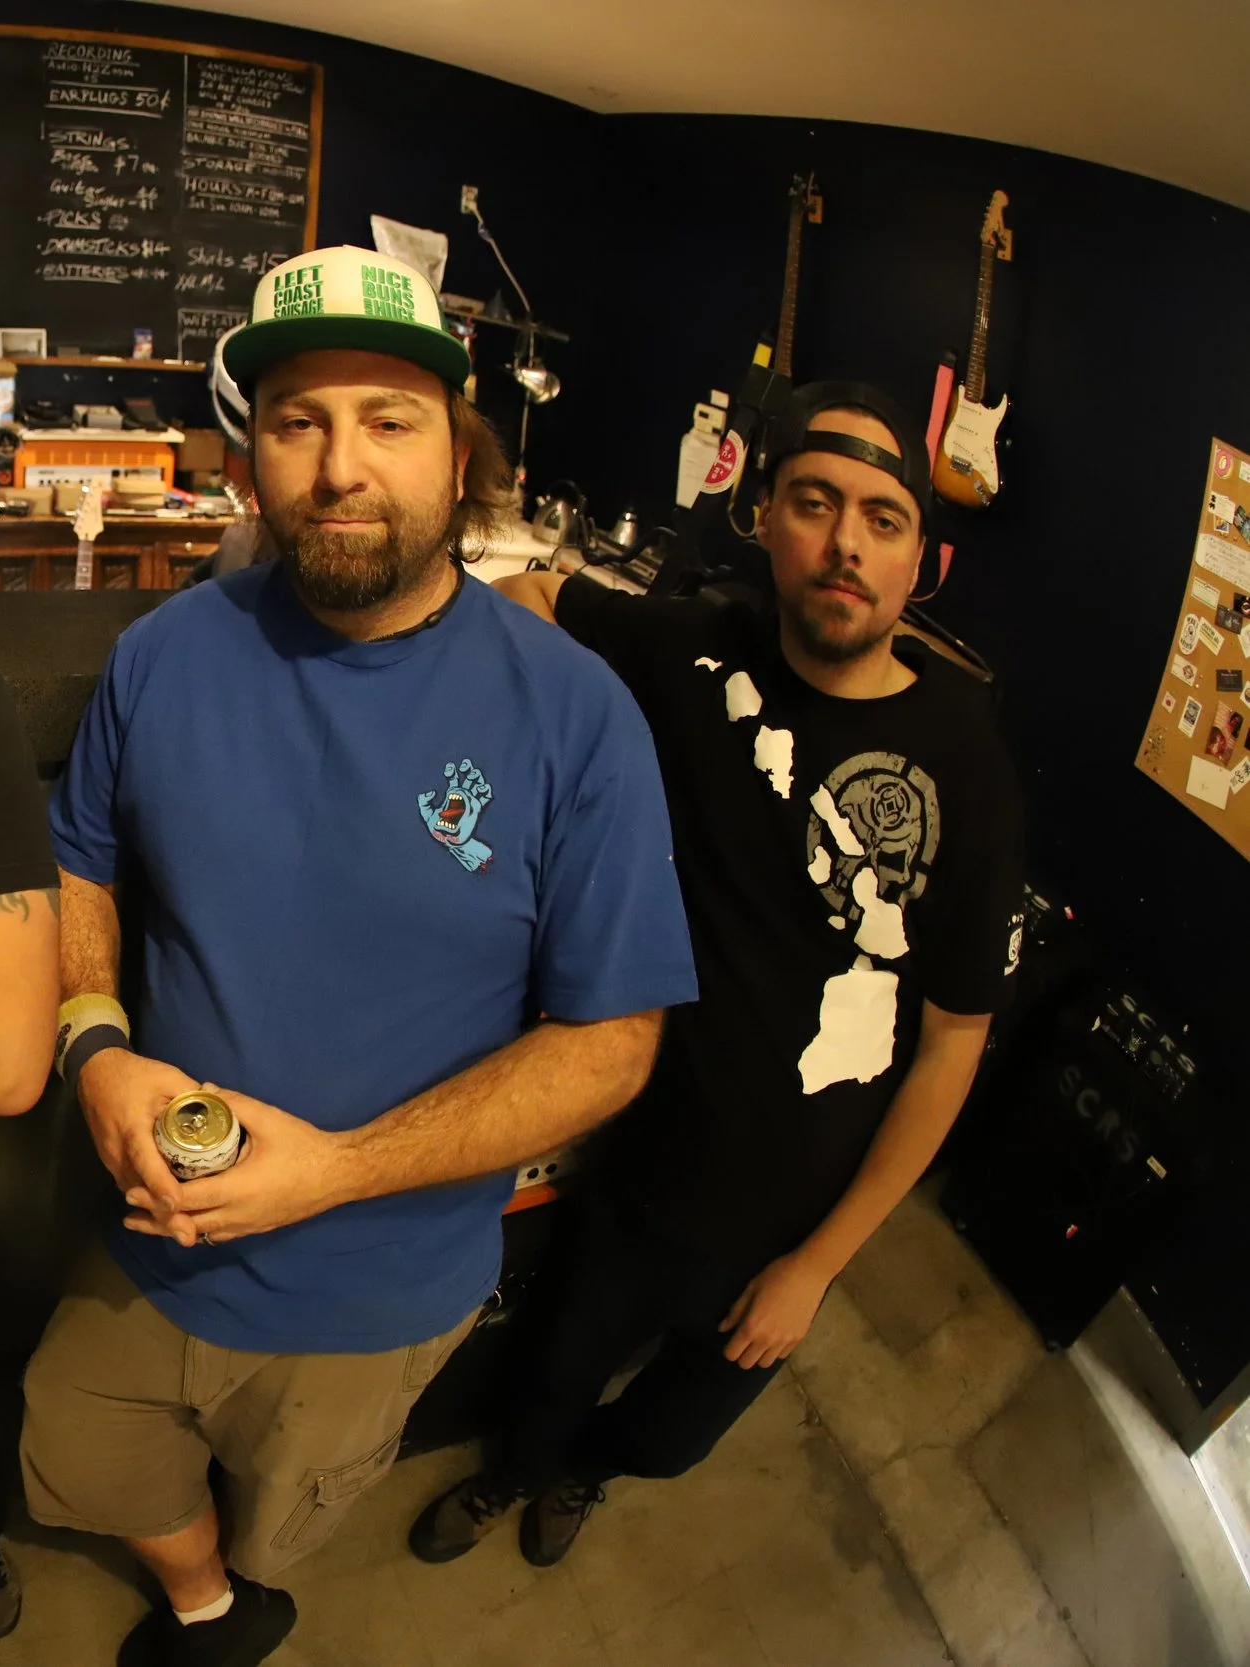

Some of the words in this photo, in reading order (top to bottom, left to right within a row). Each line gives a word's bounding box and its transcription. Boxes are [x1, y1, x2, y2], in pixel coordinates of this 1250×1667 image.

[47, 42, 133, 62] RECORDING
[50, 89, 130, 106] EARPLUGS
[183, 157, 256, 174] STORAGE
[185, 176, 243, 196] HOURS
[275, 264, 323, 292] LEFT
[361, 264, 413, 292] NICE
[274, 281, 323, 309] COAST
[362, 281, 415, 310] BUNS
[274, 297, 324, 319] SAUSAGE
